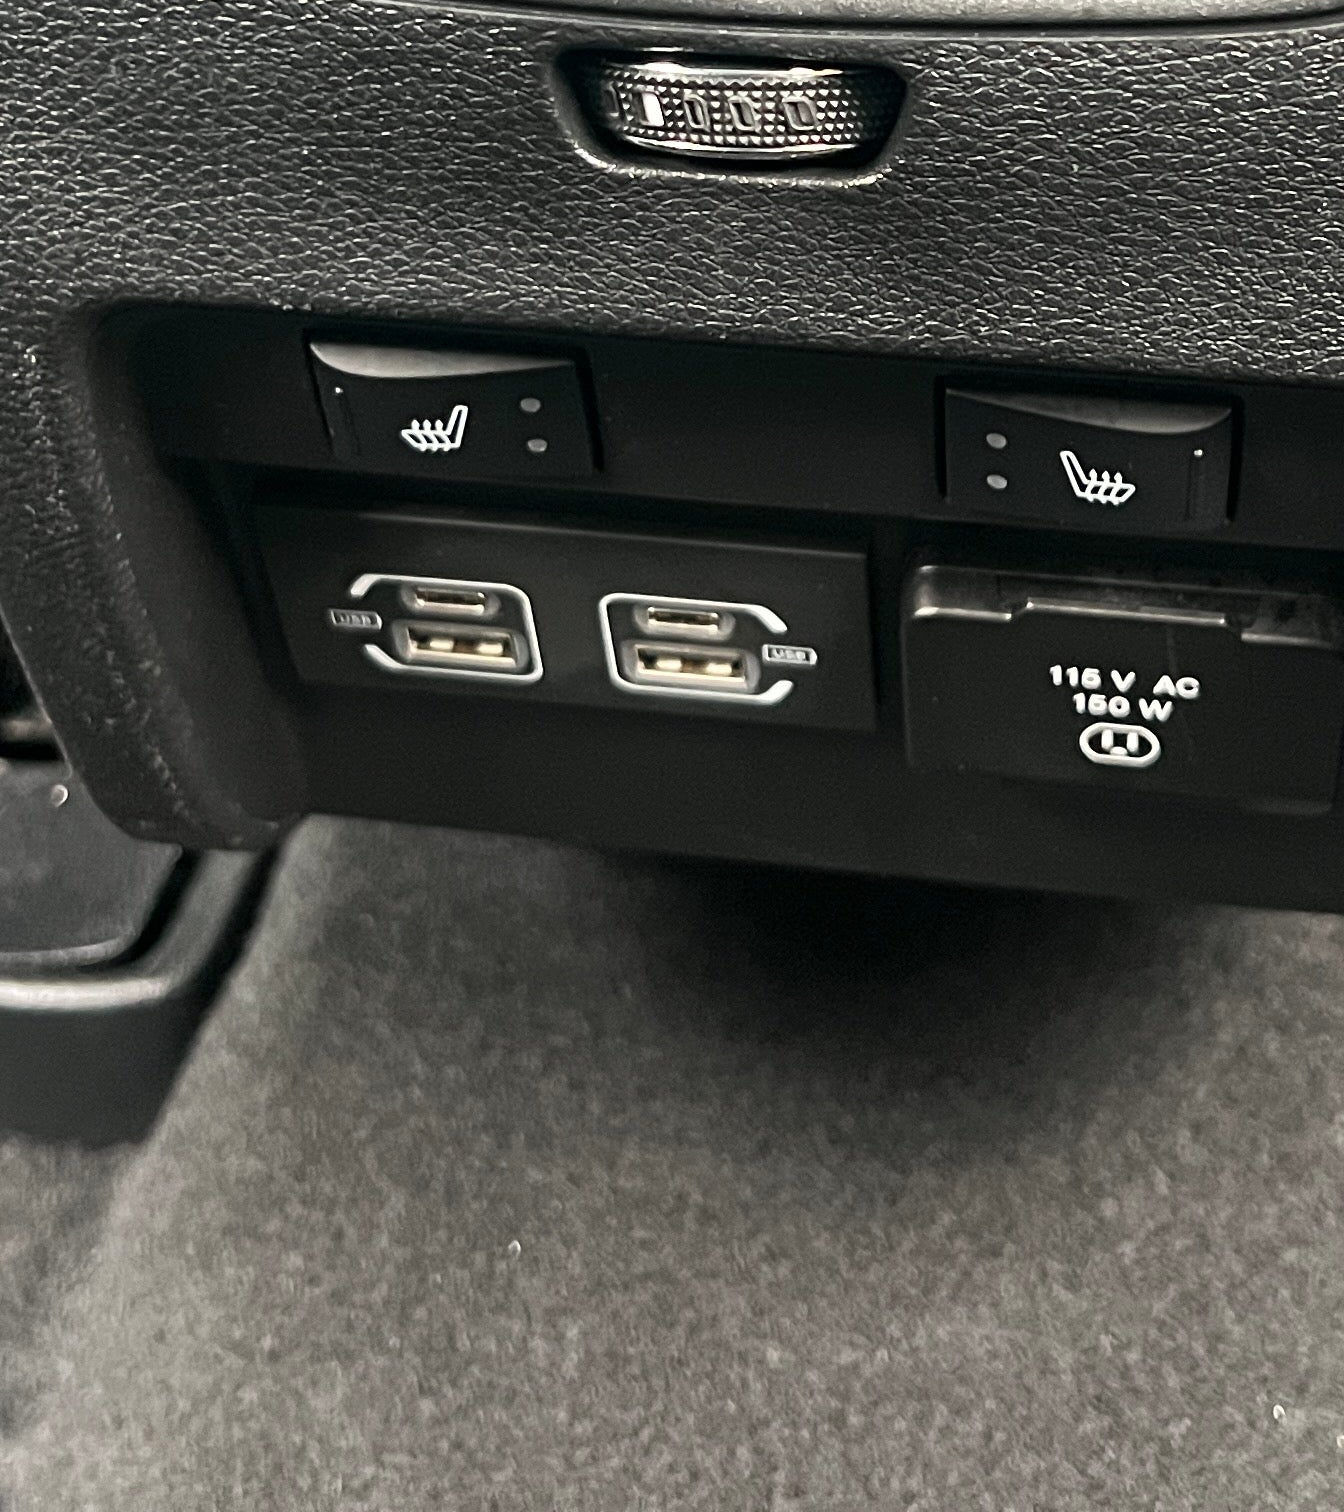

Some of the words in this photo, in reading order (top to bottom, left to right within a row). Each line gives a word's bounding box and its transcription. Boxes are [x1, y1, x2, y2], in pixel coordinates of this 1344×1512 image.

[769, 646, 808, 662] USB
[1049, 664, 1102, 690] 115
[1110, 669, 1136, 693] V
[1152, 674, 1200, 700] AC
[1072, 692, 1131, 718] 150
[1138, 697, 1173, 722] W
